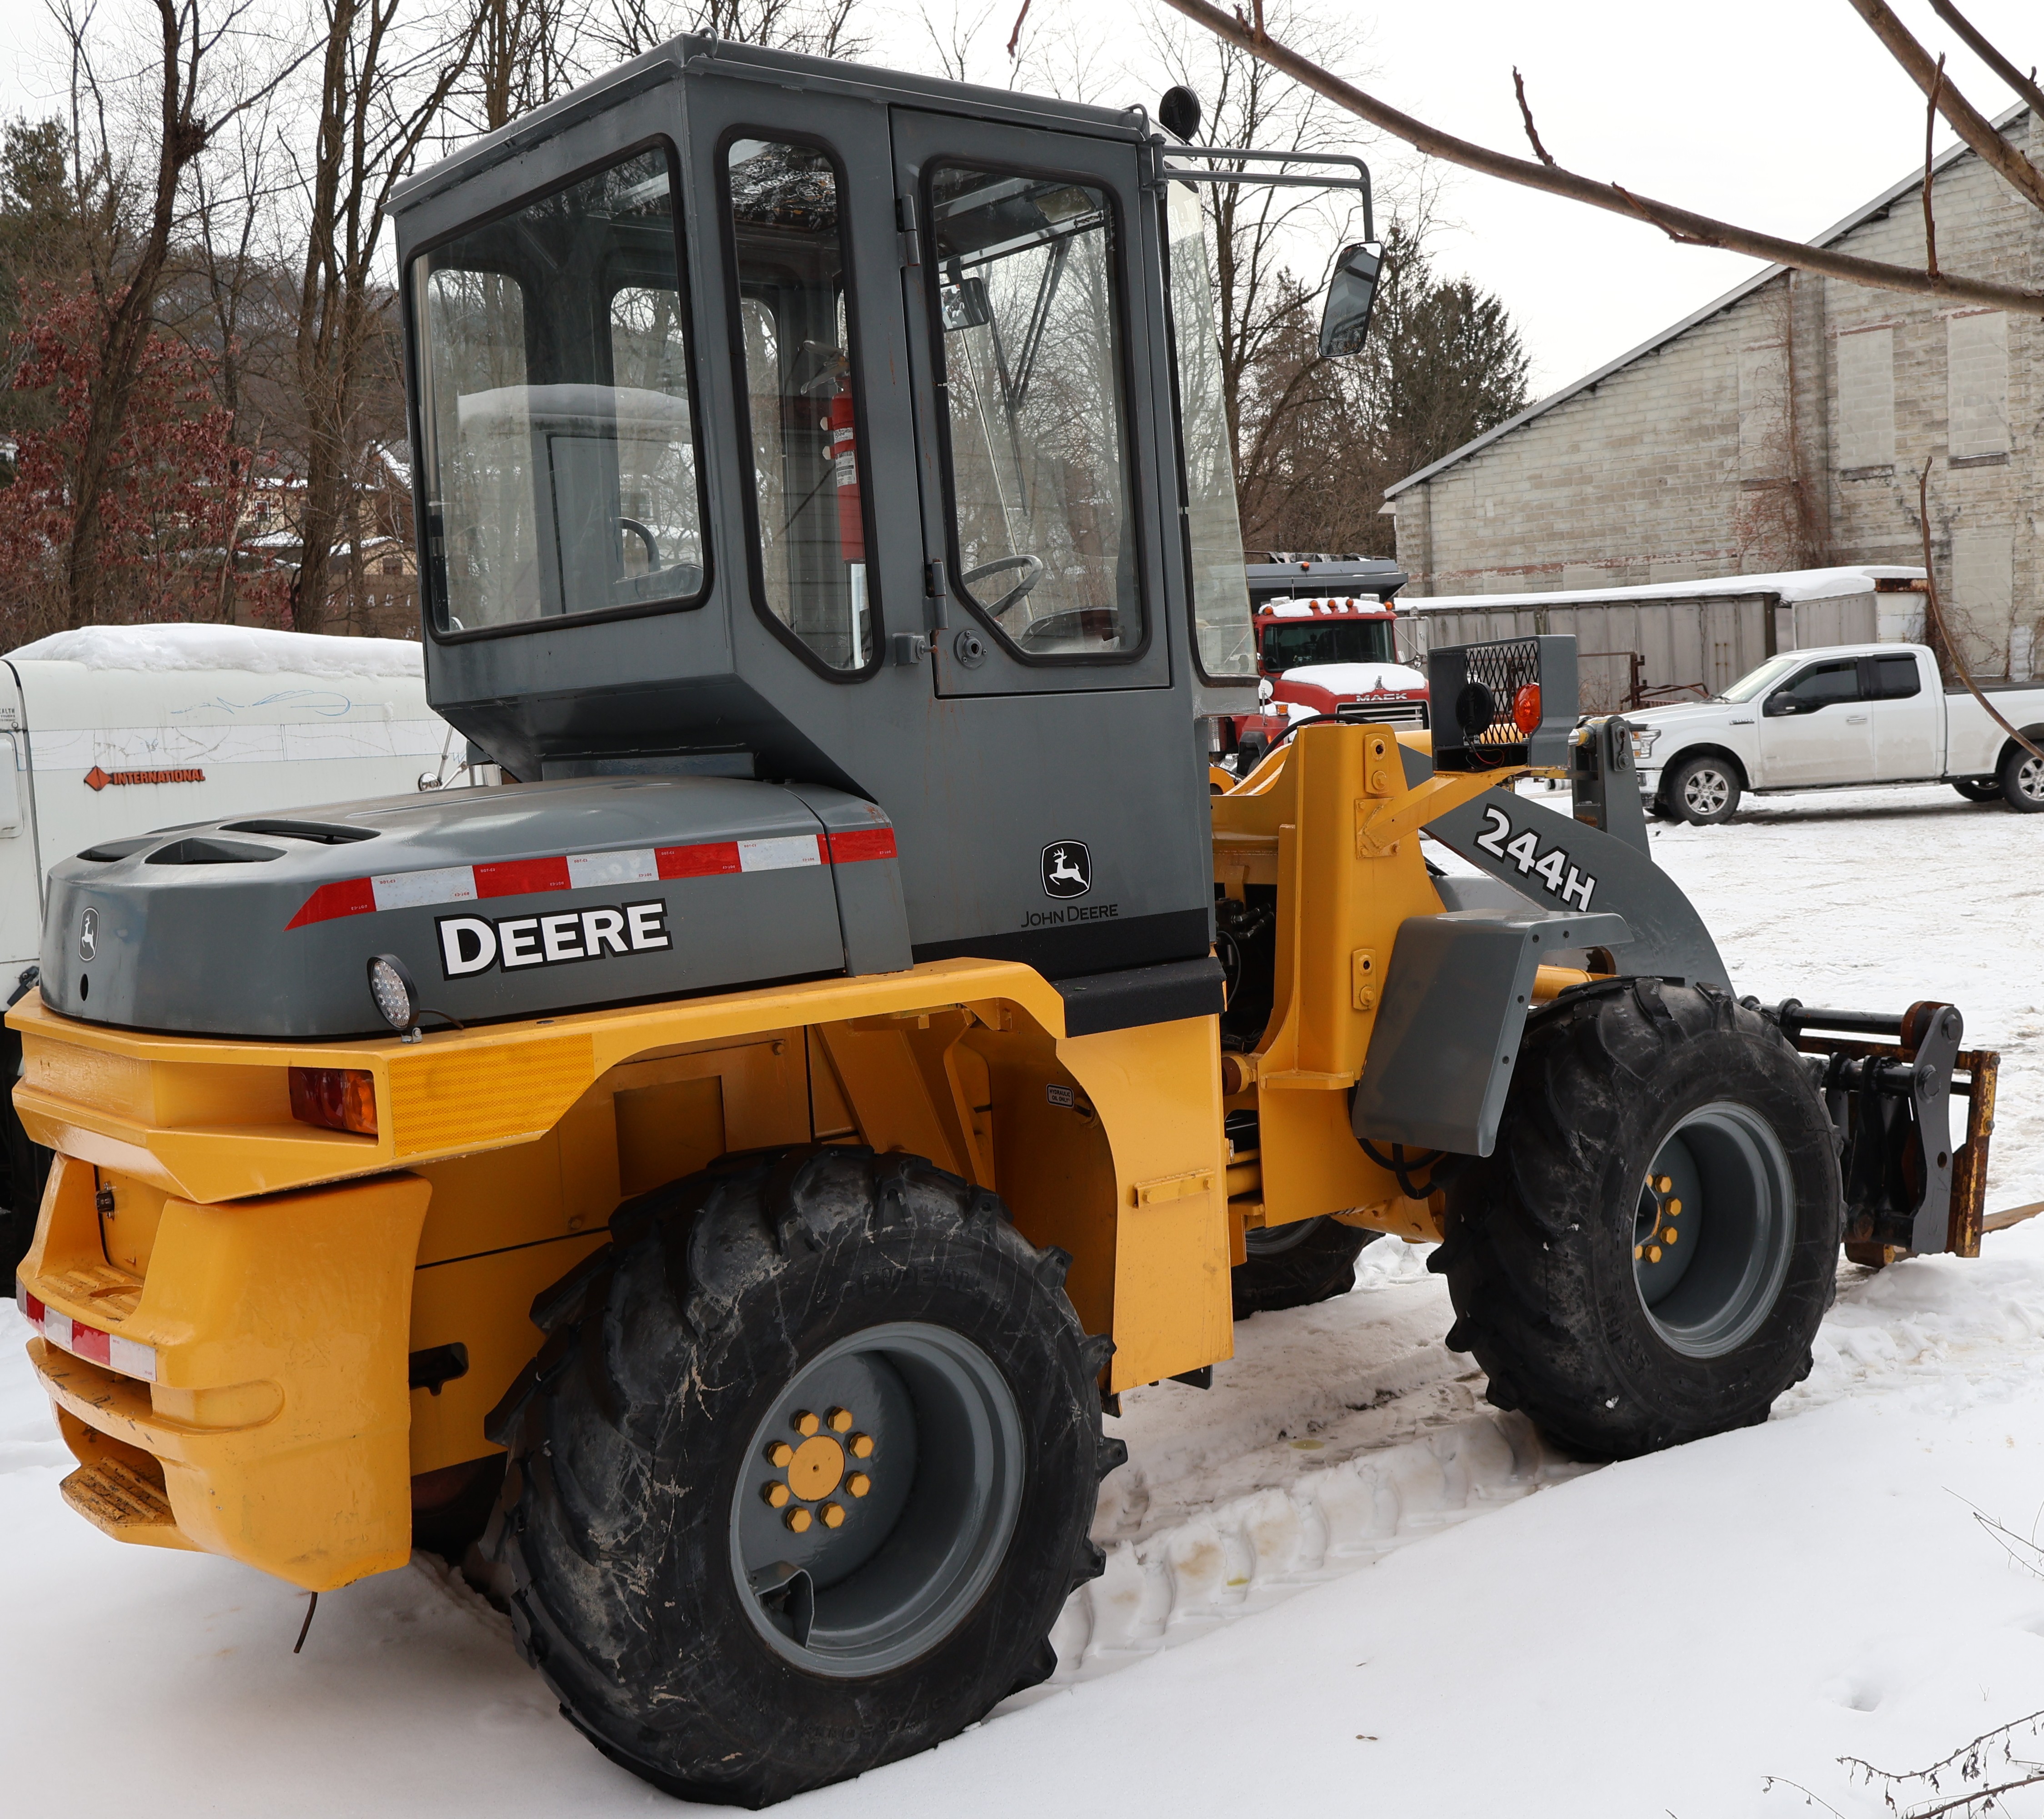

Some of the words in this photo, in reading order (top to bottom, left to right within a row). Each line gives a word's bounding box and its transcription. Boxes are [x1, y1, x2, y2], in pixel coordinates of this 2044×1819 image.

[1356, 693, 1408, 702] MACK
[113, 769, 205, 785] INTERNATIONAL
[1475, 805, 1597, 913] 244H
[1021, 910, 1065, 928] JOHN
[1067, 904, 1118, 922] DEERE
[438, 901, 670, 977] DEERE
[1049, 1089, 1071, 1097] HYDRAULIC
